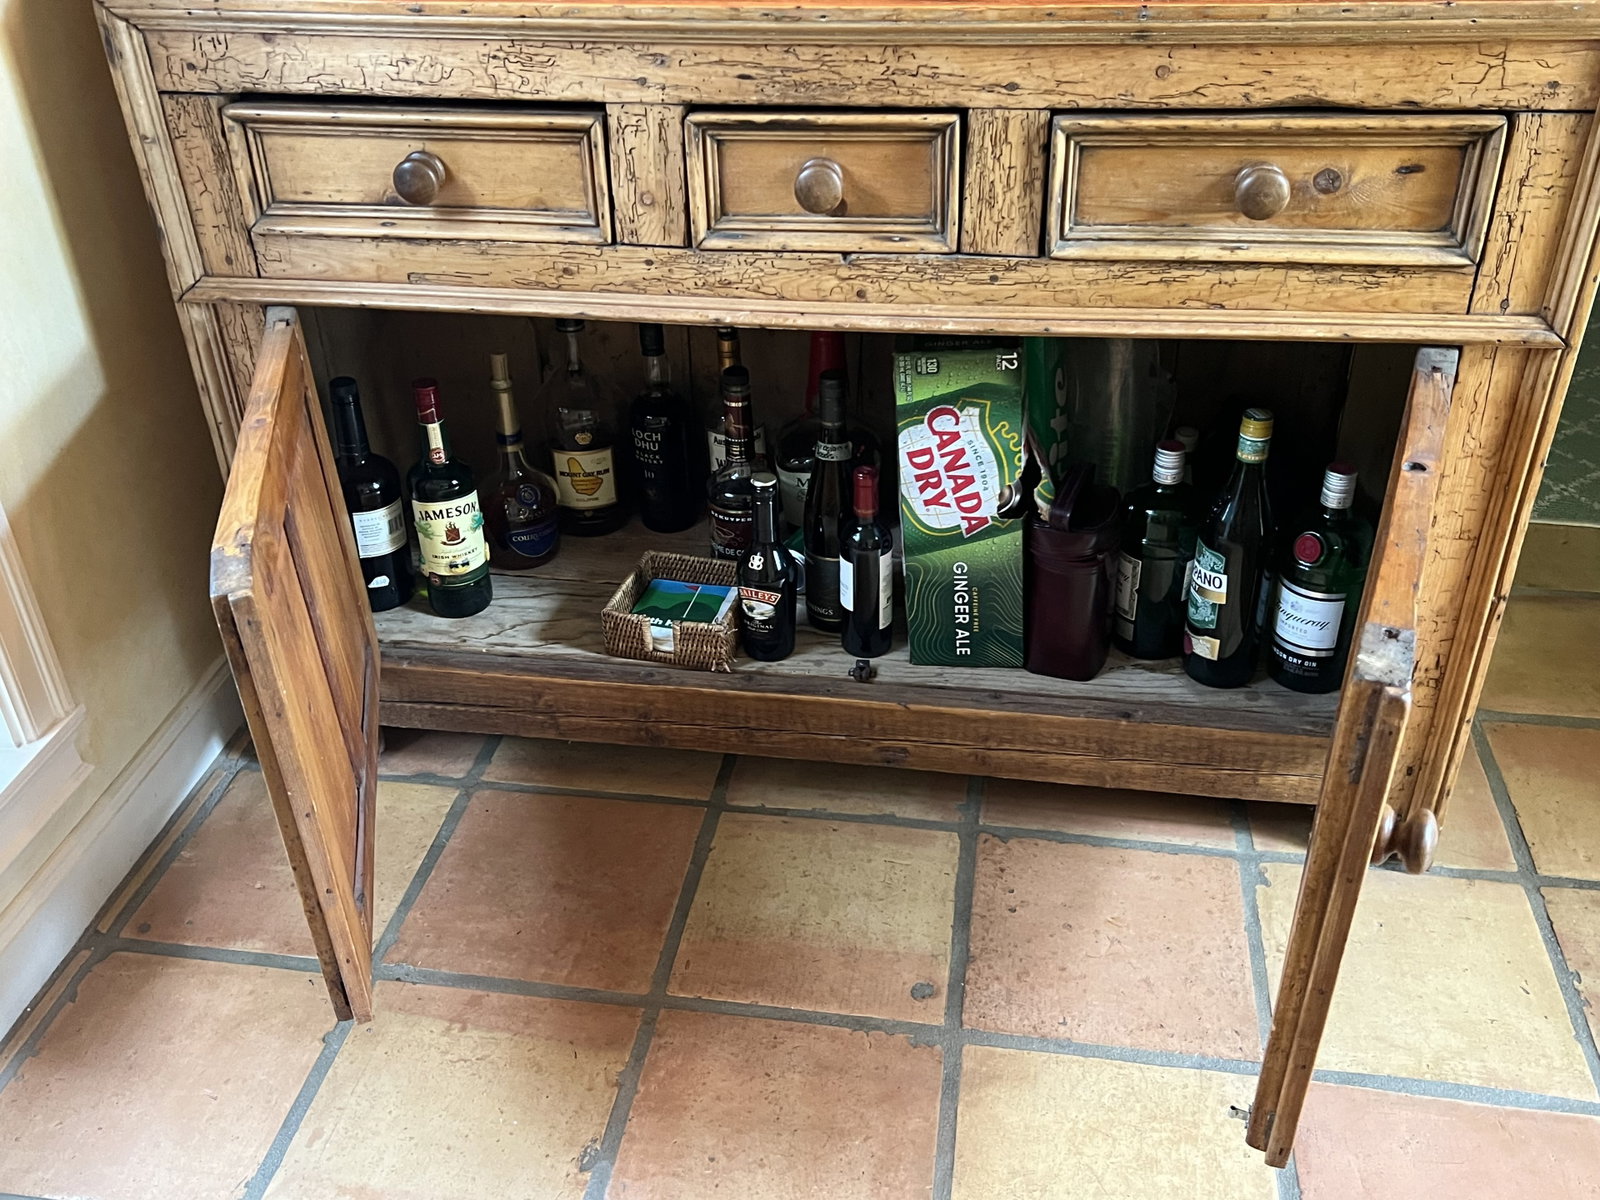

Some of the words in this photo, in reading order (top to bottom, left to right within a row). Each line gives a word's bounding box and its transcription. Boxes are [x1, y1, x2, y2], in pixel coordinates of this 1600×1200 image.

[926, 358, 937, 373] 130
[1001, 352, 1018, 371] 12
[635, 438, 658, 451] DHU
[559, 470, 582, 478] MOUNT
[597, 468, 610, 476] RUM
[926, 407, 990, 535] CANADA
[967, 440, 982, 467] SINCE
[981, 470, 989, 492] 1904
[906, 447, 951, 508] DRY
[418, 501, 477, 522] JAMESON
[953, 561, 969, 623] GINGER
[955, 628, 971, 656] ALE
[1288, 656, 1303, 665] DRY
[1304, 660, 1318, 668] GIN
